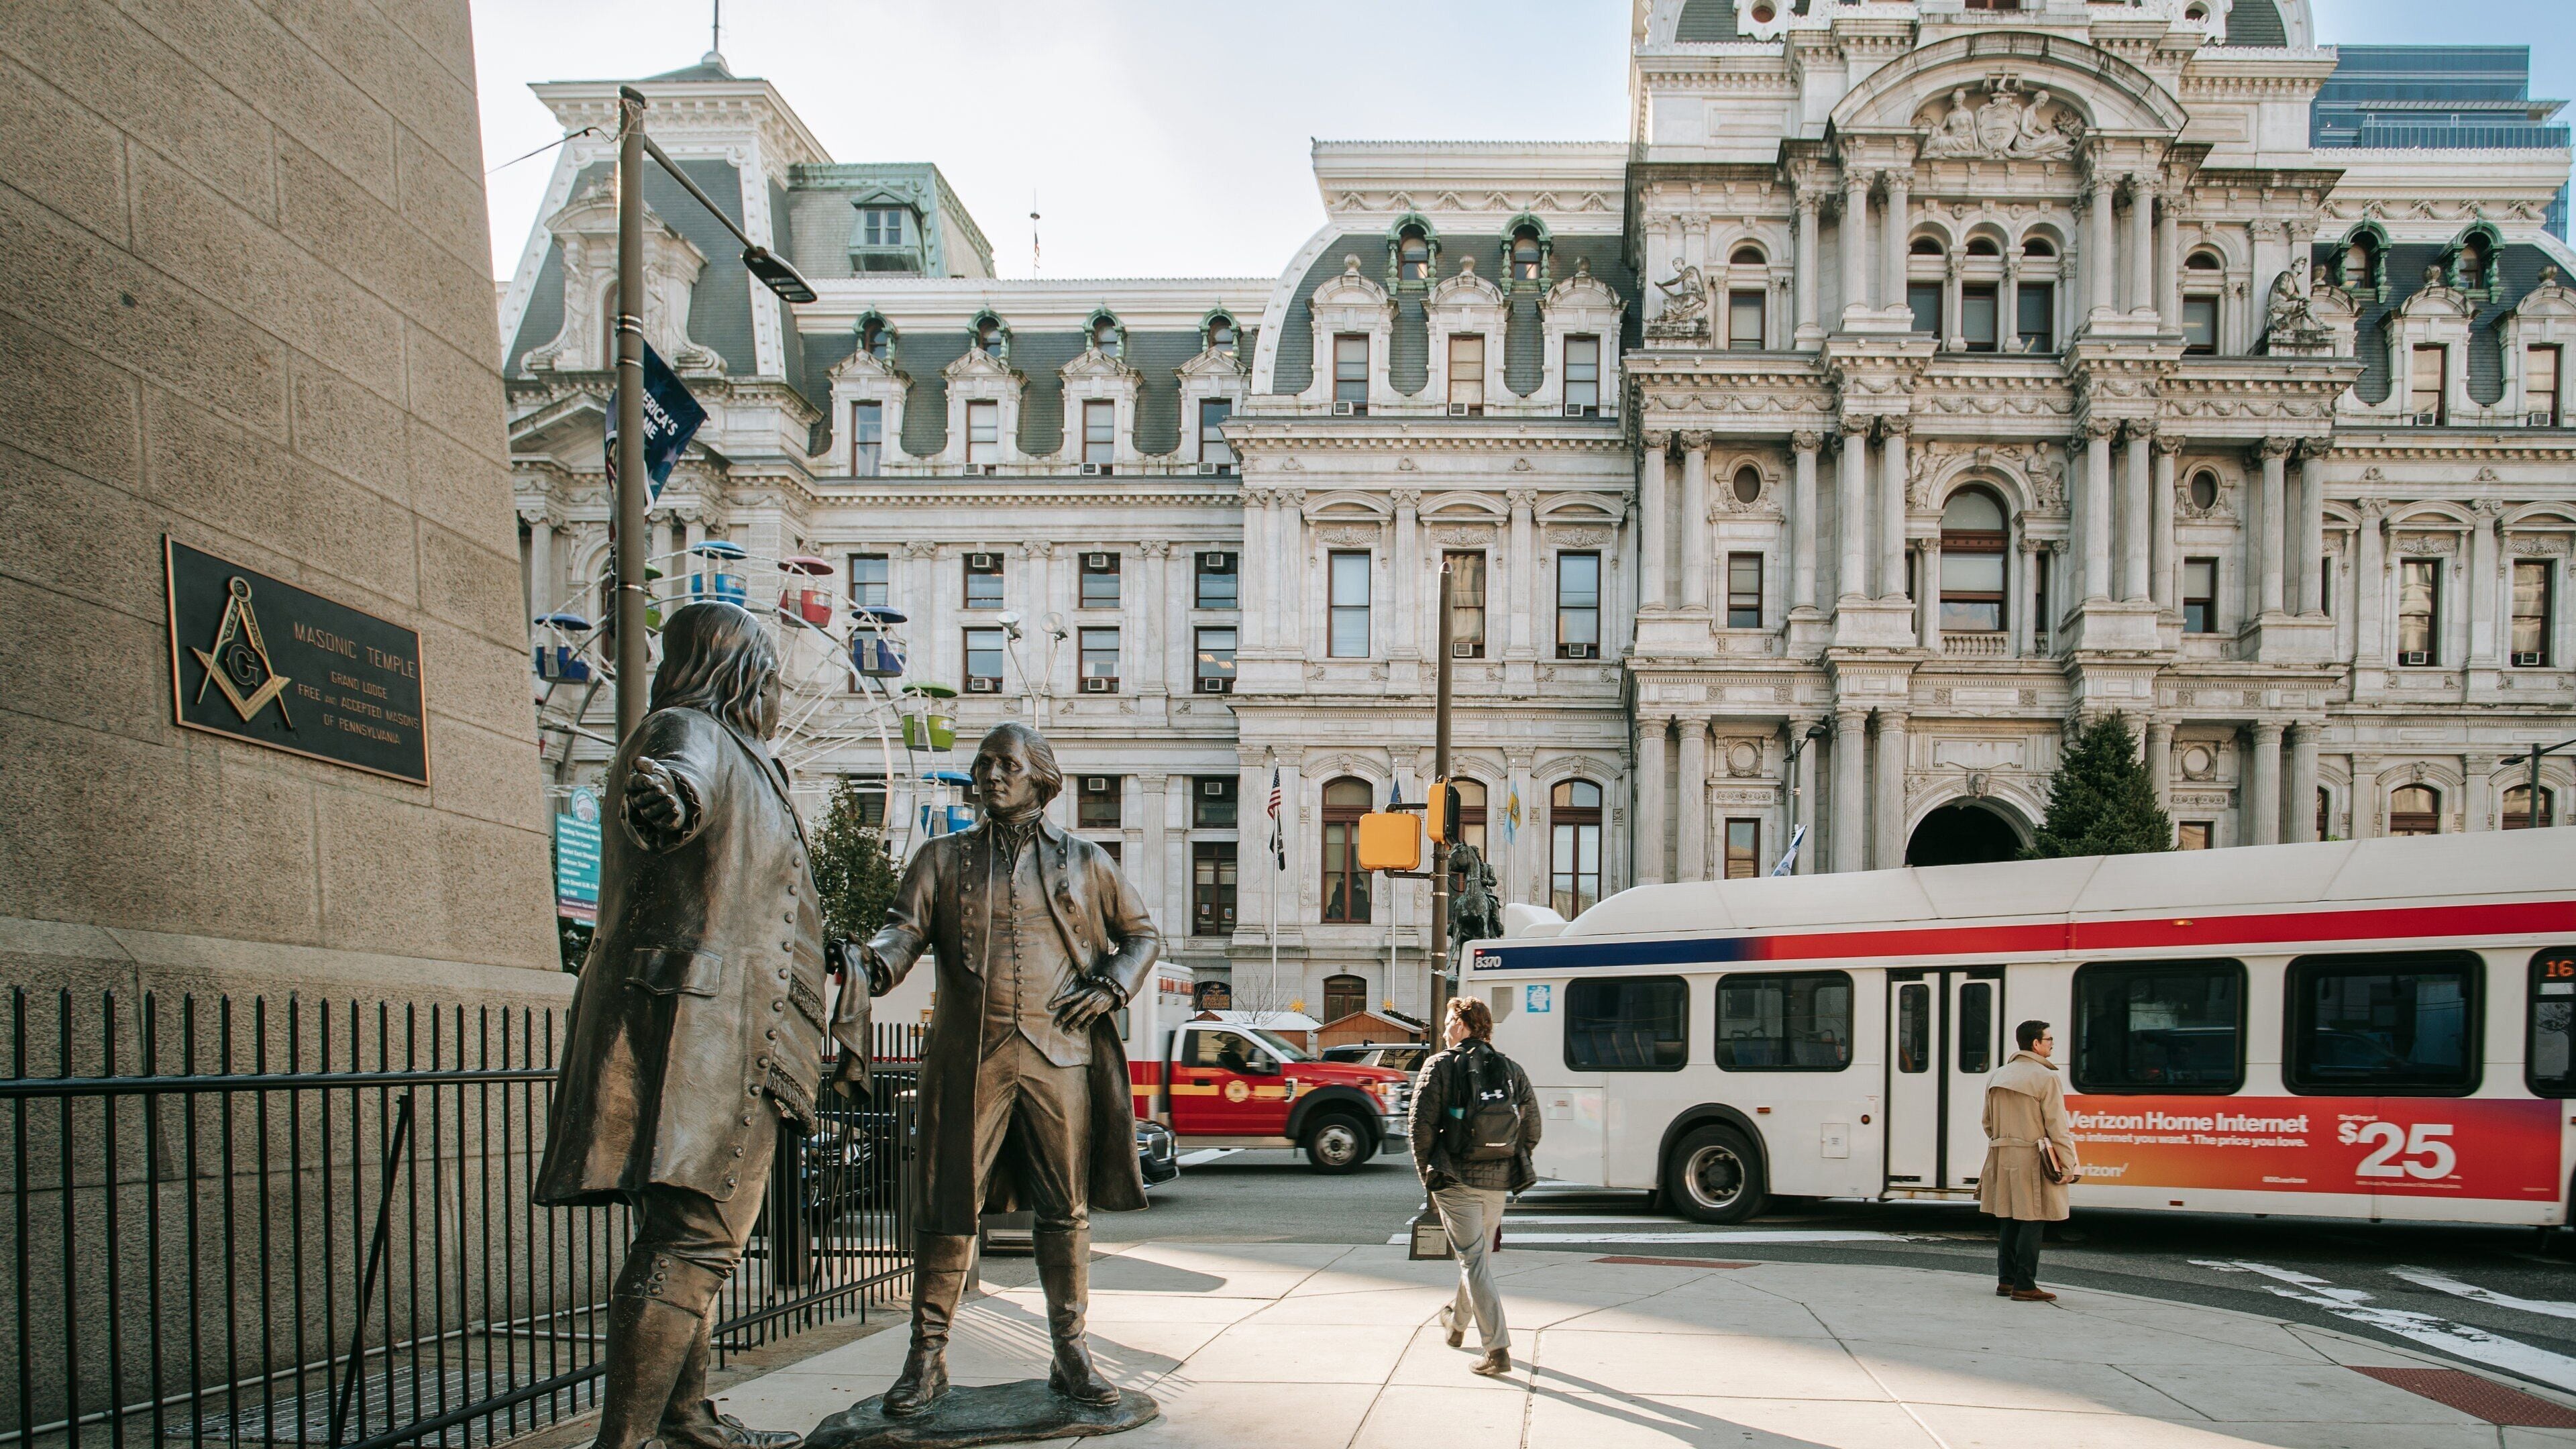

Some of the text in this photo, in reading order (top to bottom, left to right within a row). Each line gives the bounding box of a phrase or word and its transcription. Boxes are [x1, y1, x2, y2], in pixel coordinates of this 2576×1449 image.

[643, 388, 678, 436] ERICA'S
[643, 416, 659, 440] ME
[294, 622, 416, 679] MASONIC TEMPLE
[226, 644, 260, 687] G
[331, 672, 388, 700] GRAND LODGE
[298, 684, 321, 701] FREE
[341, 697, 382, 718] ACCEPTED
[386, 710, 419, 729] MASONS
[323, 714, 400, 745] OF PENNSYLVANIA
[1475, 956, 1502, 968] 8370
[2545, 960, 2575, 977] 16
[2065, 1110, 2310, 1133] Verizon Home Internet
[2086, 1132, 2133, 1143] internet
[2133, 1134, 2157, 1145] you
[2192, 1134, 2216, 1145] The
[2216, 1135, 2251, 1147] price
[2251, 1138, 2277, 1148] you
[2277, 1136, 2309, 1147] love.
[2337, 1121, 2457, 1180] $25
[2080, 1163, 2121, 1177] rizon
